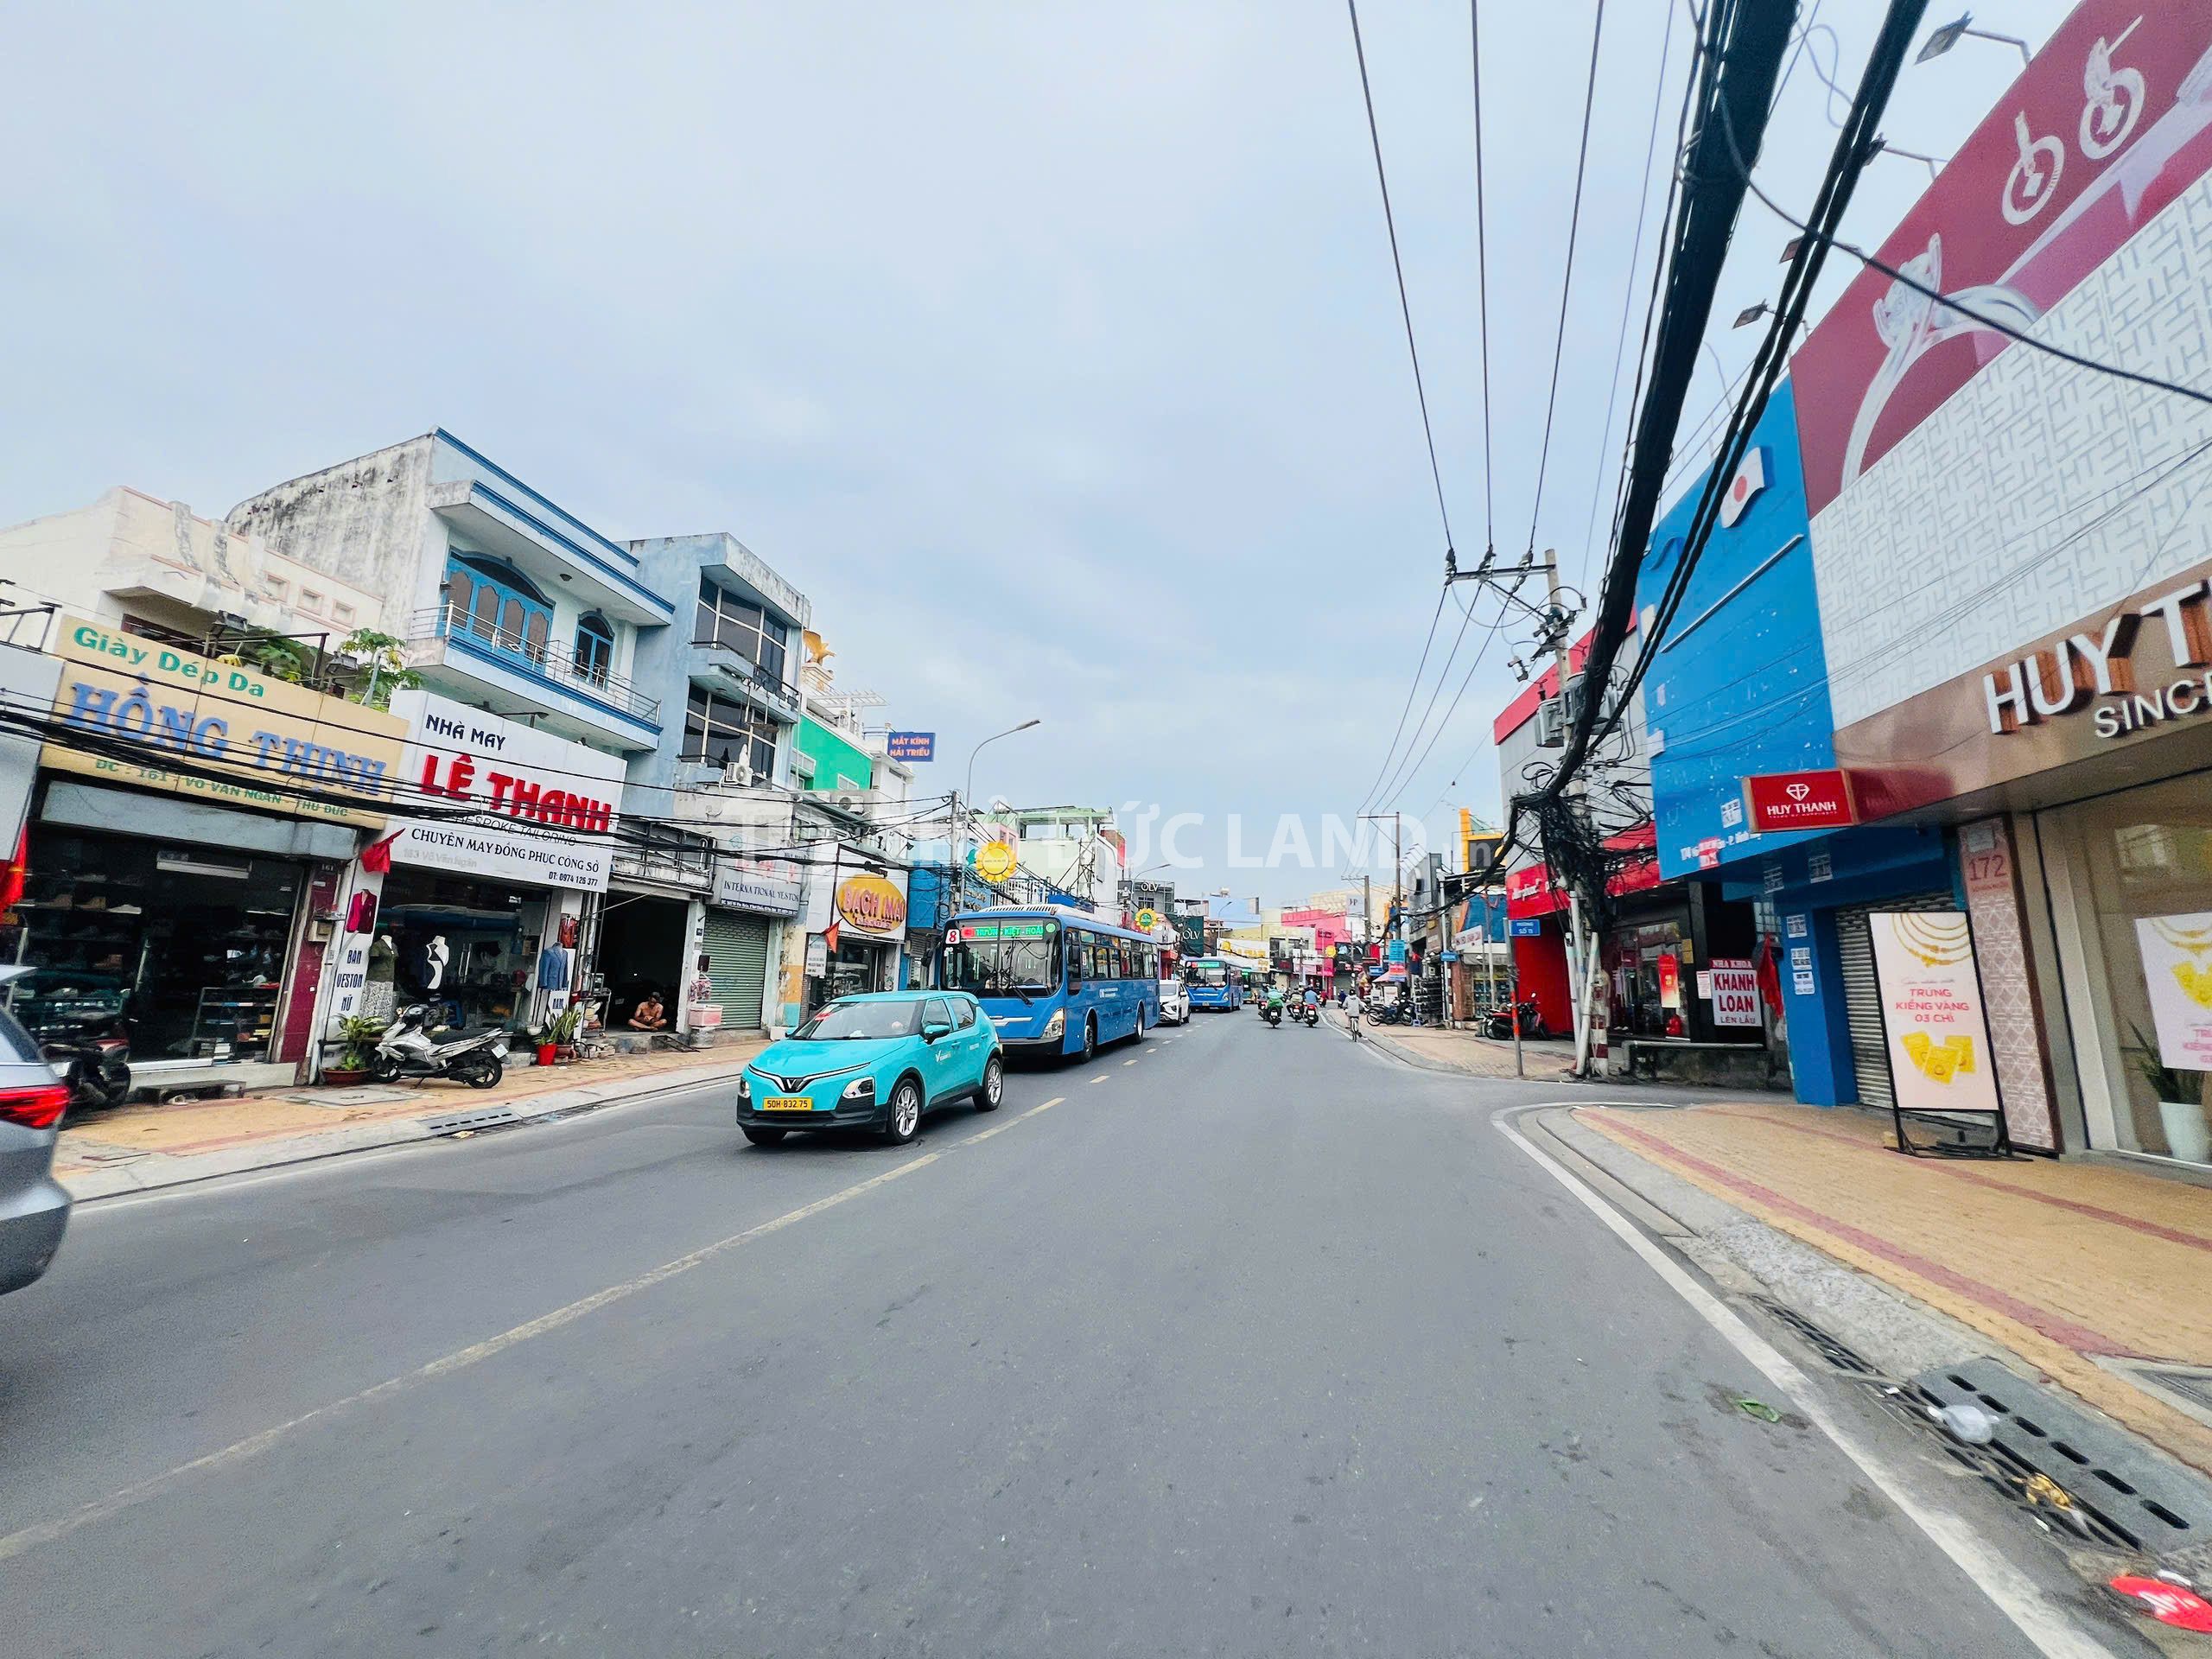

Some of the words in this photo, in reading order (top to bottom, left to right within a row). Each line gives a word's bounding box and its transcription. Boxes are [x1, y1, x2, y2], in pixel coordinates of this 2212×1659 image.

[73, 626, 149, 665] Giày
[158, 651, 219, 685] Dép
[228, 672, 264, 697] Da
[1983, 616, 2122, 734] HUY
[2139, 579, 2212, 667] T
[425, 711, 466, 741] NHÀ
[470, 728, 505, 751] MAY
[419, 753, 475, 802] LÊ
[486, 772, 612, 832] THANH
[1767, 804, 1792, 816] HUY
[1794, 801, 1837, 814] THANH
[411, 827, 464, 848] CHUYÊN
[467, 837, 493, 855] MAY
[1968, 854, 2007, 881] 172
[949, 930, 957, 944] 8
[1714, 972, 1756, 991] KHANH
[1719, 995, 1755, 1013] LOAN
[1915, 1014, 1929, 1022] 03
